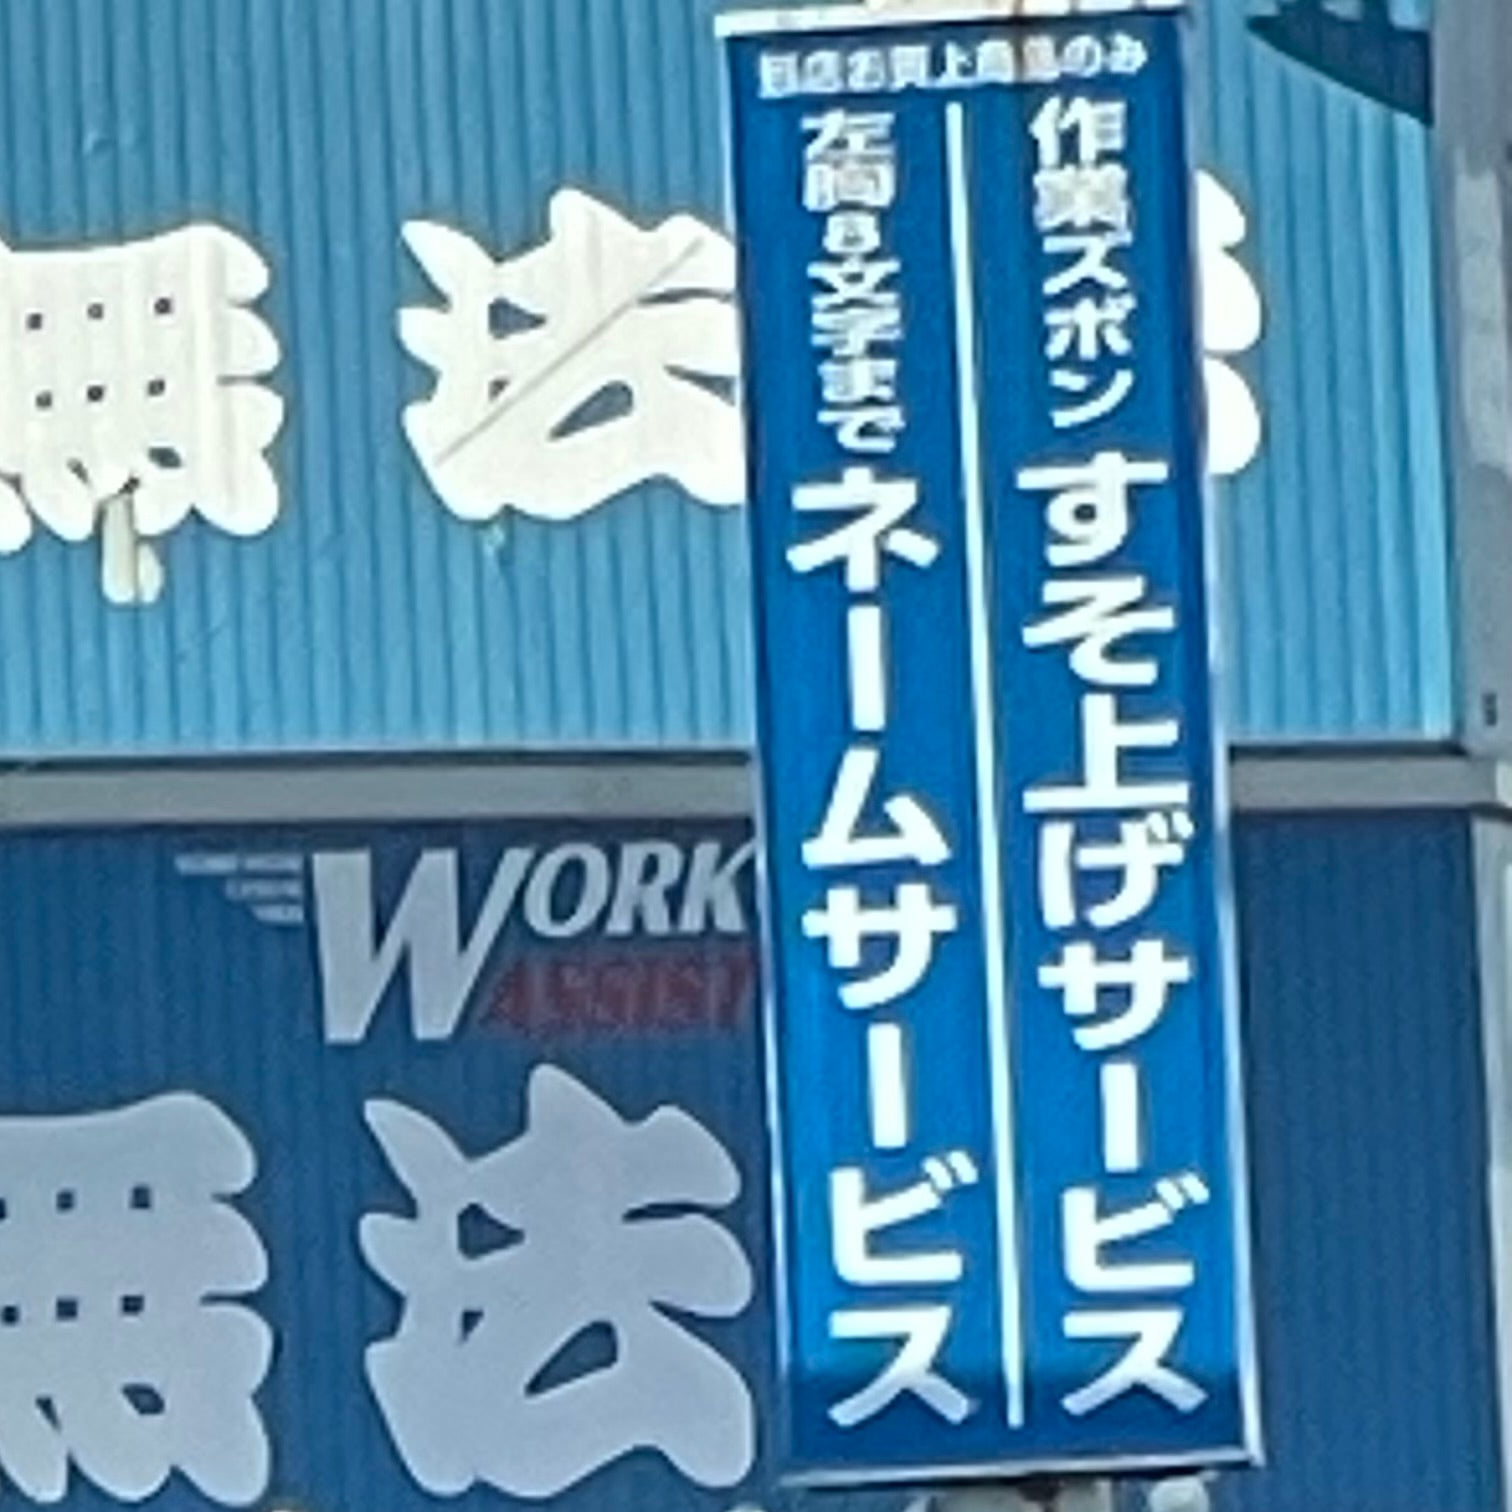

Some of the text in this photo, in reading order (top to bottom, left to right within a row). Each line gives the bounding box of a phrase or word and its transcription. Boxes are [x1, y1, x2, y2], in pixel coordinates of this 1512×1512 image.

[311, 838, 756, 1043] WORK
[786, 467, 979, 1428] ネームサービス
[1016, 450, 1209, 1415] すそ上げサービス
